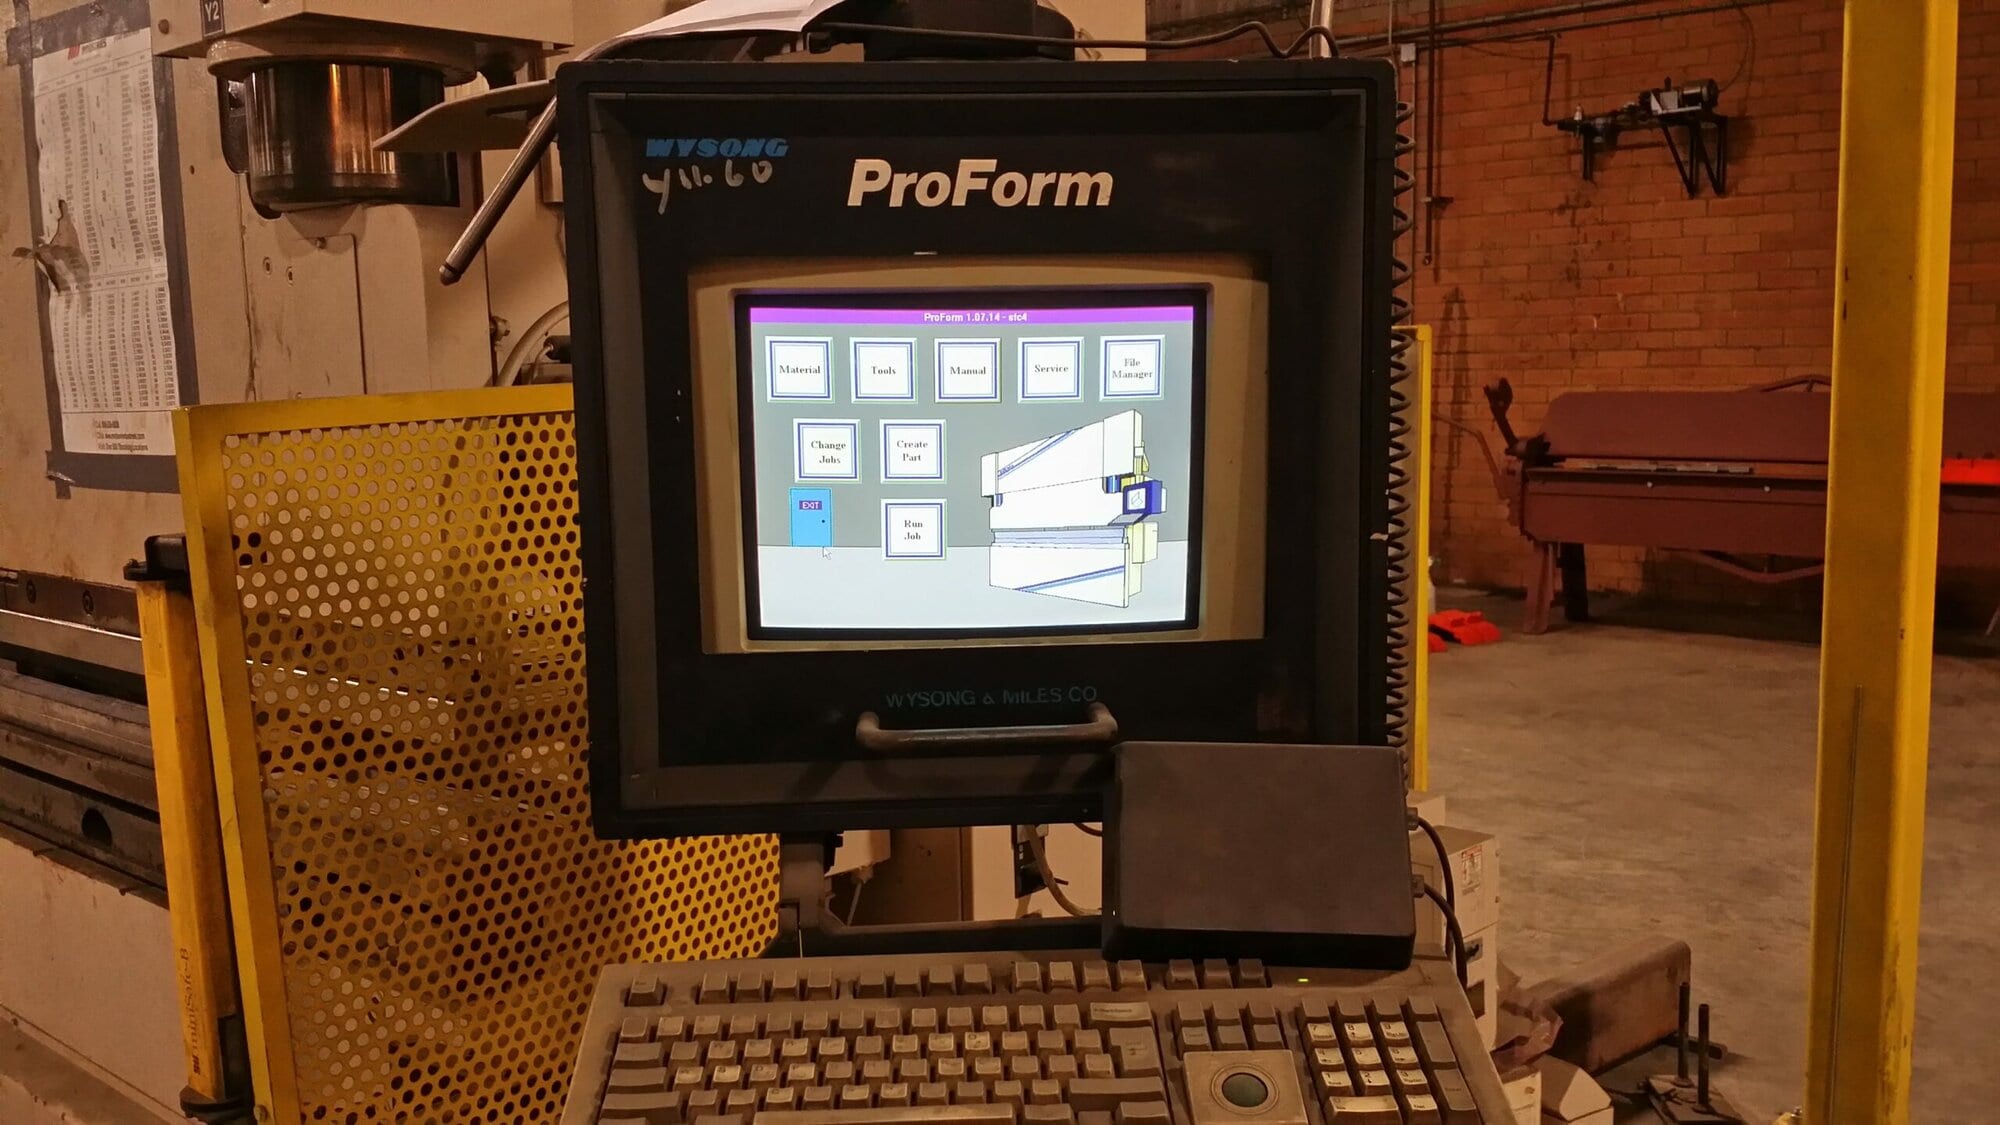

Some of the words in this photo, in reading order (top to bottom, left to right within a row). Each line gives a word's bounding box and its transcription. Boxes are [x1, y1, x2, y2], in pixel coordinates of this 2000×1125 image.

[205, 1, 220, 22] Y2
[646, 138, 789, 157] WYSONG
[847, 159, 1114, 207] ProForm
[924, 312, 963, 322] ProForm
[966, 312, 1000, 322] 1.07.14
[1124, 358, 1141, 367] File
[779, 365, 821, 375] Material
[871, 366, 897, 375] Tools
[950, 366, 987, 376] Manual
[1034, 364, 1069, 373] Service
[1111, 370, 1153, 380] Manager
[810, 440, 847, 451] Change
[896, 439, 928, 449] Create
[818, 455, 841, 464] Jobs
[902, 453, 922, 462] Part
[802, 501, 819, 510] EXIT
[904, 519, 923, 528] Run
[904, 532, 921, 541] Job
[886, 689, 976, 708] WYSONG
[1003, 687, 1062, 704] MILES
[1069, 686, 1098, 702] CO
